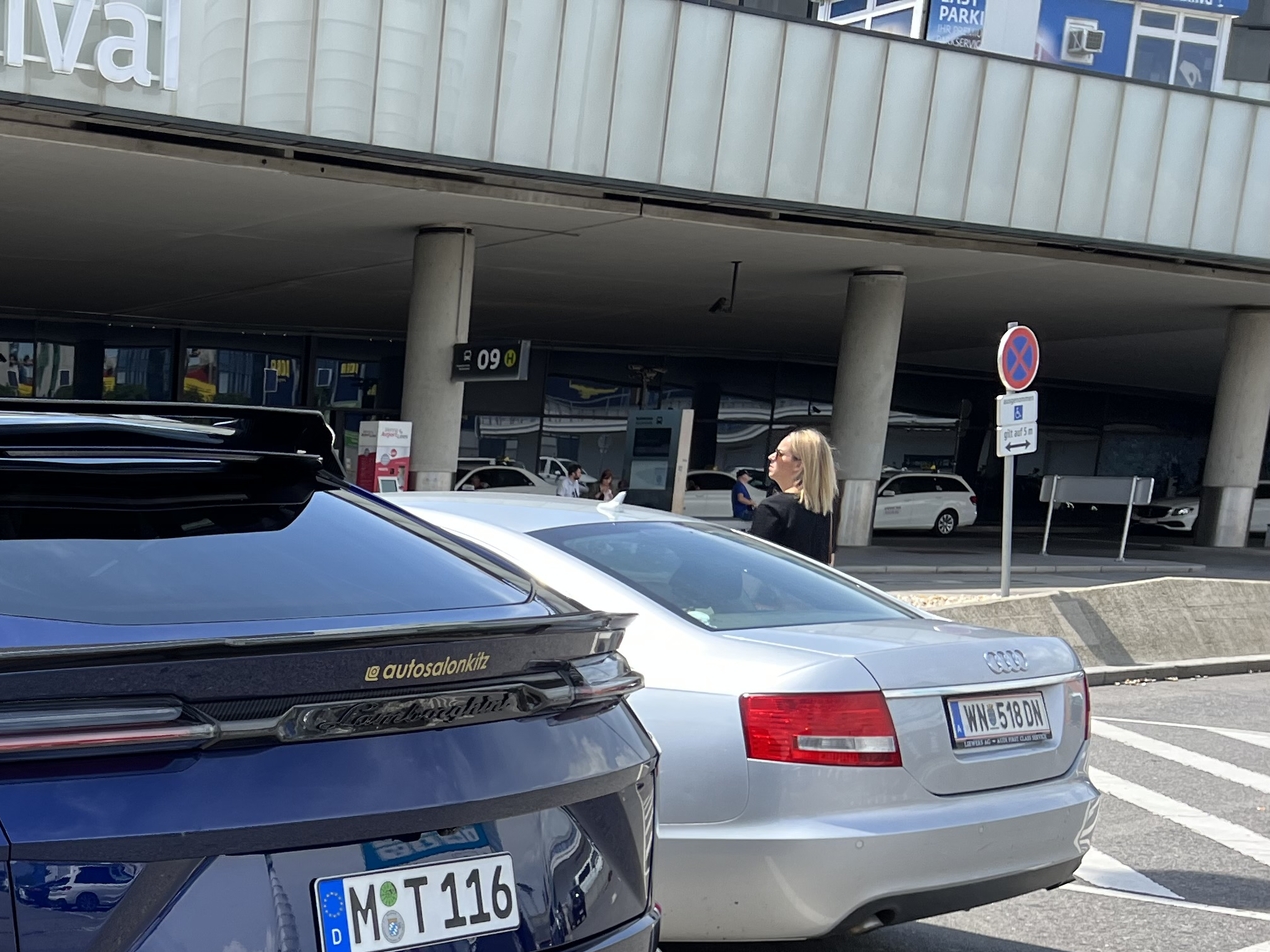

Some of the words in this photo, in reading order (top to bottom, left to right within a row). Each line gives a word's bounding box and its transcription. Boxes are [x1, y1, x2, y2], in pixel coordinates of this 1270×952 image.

[477, 348, 501, 371] 09
[1023, 426, 1027, 436] 5
[382, 651, 491, 680] autosalonkitz
[963, 703, 989, 732] WN
[996, 701, 1024, 729] 518
[1022, 699, 1044, 727] DN
[331, 928, 343, 945] D
[348, 883, 380, 944] M
[403, 875, 428, 933] T
[440, 865, 513, 930] 116
